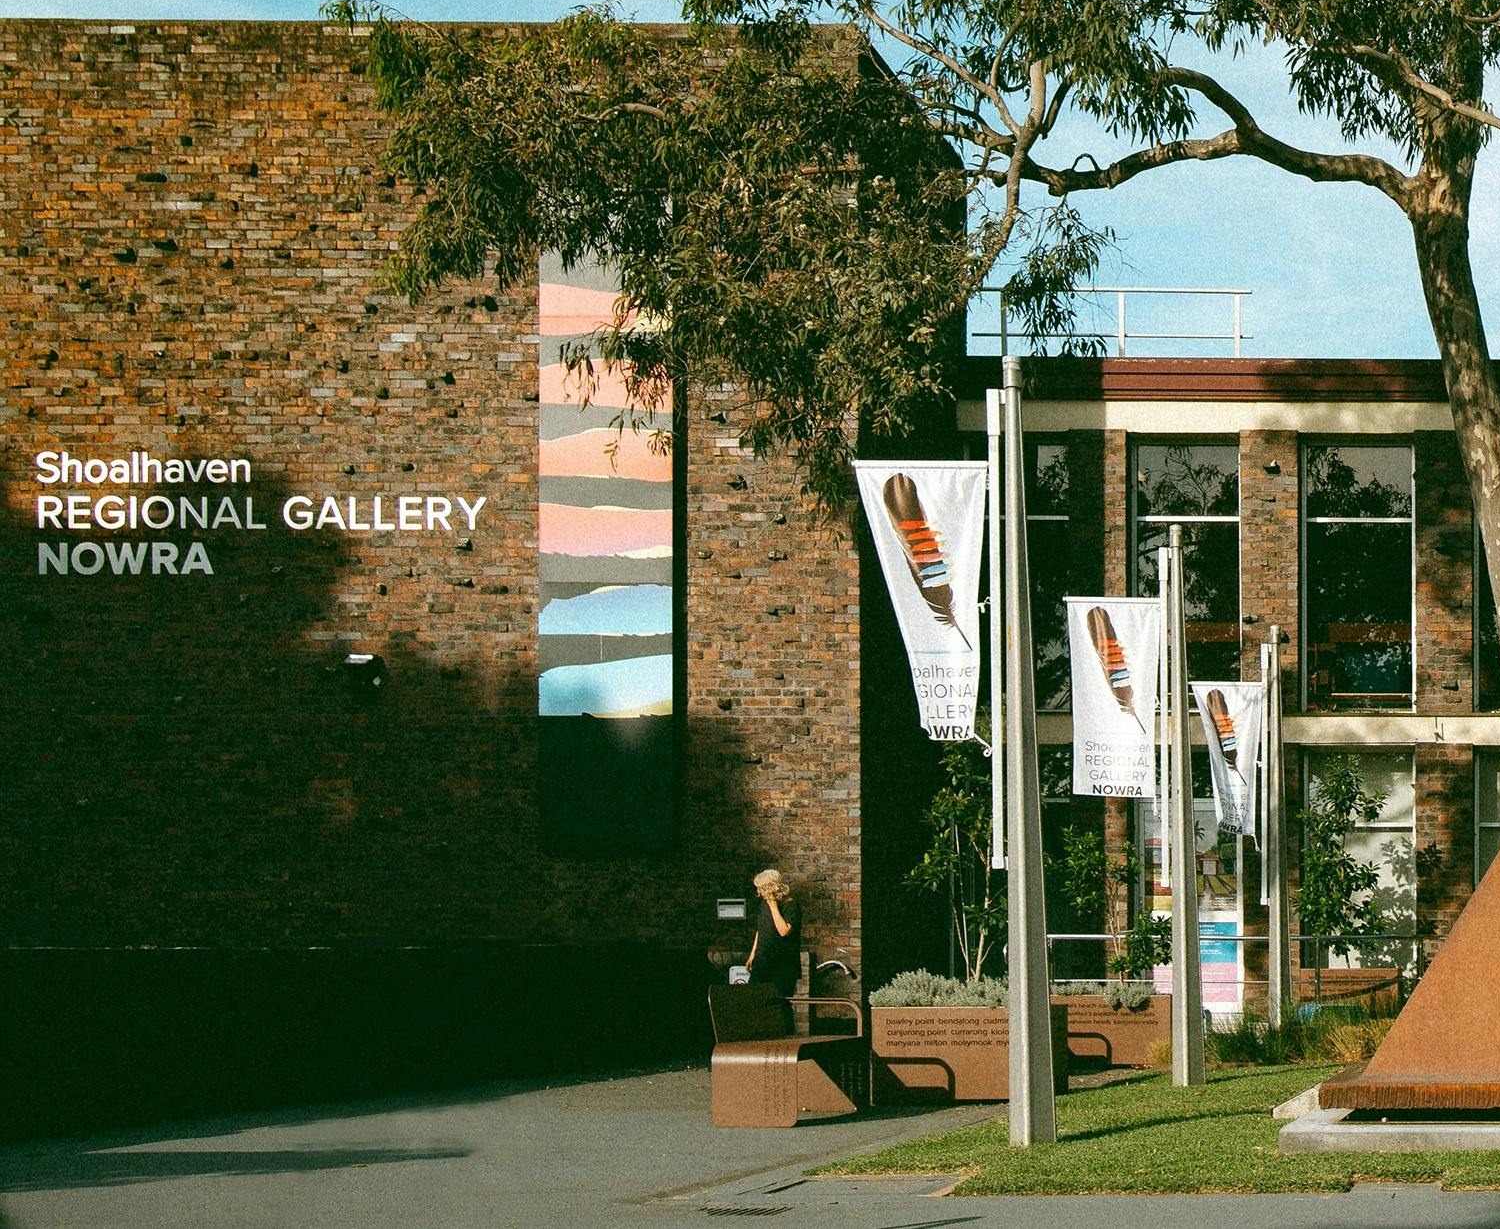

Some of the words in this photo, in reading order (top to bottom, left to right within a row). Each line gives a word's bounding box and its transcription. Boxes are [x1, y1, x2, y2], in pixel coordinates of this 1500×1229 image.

[36, 451, 251, 484] Shoalhaven
[37, 496, 266, 530] REGIONAL
[283, 496, 487, 531] GALLERY
[38, 542, 214, 575] NOWRA
[1085, 741, 1151, 753] Shoaven
[1085, 755, 1150, 768] REGIONAL
[1089, 770, 1147, 781] GALLERY
[1092, 784, 1143, 796] NOWRA
[886, 1018, 913, 1026] bawley
[915, 1018, 935, 1026] point
[938, 1018, 980, 1026] bendalong
[950, 1029, 988, 1037] currarong
[950, 1039, 993, 1047] mollymook
